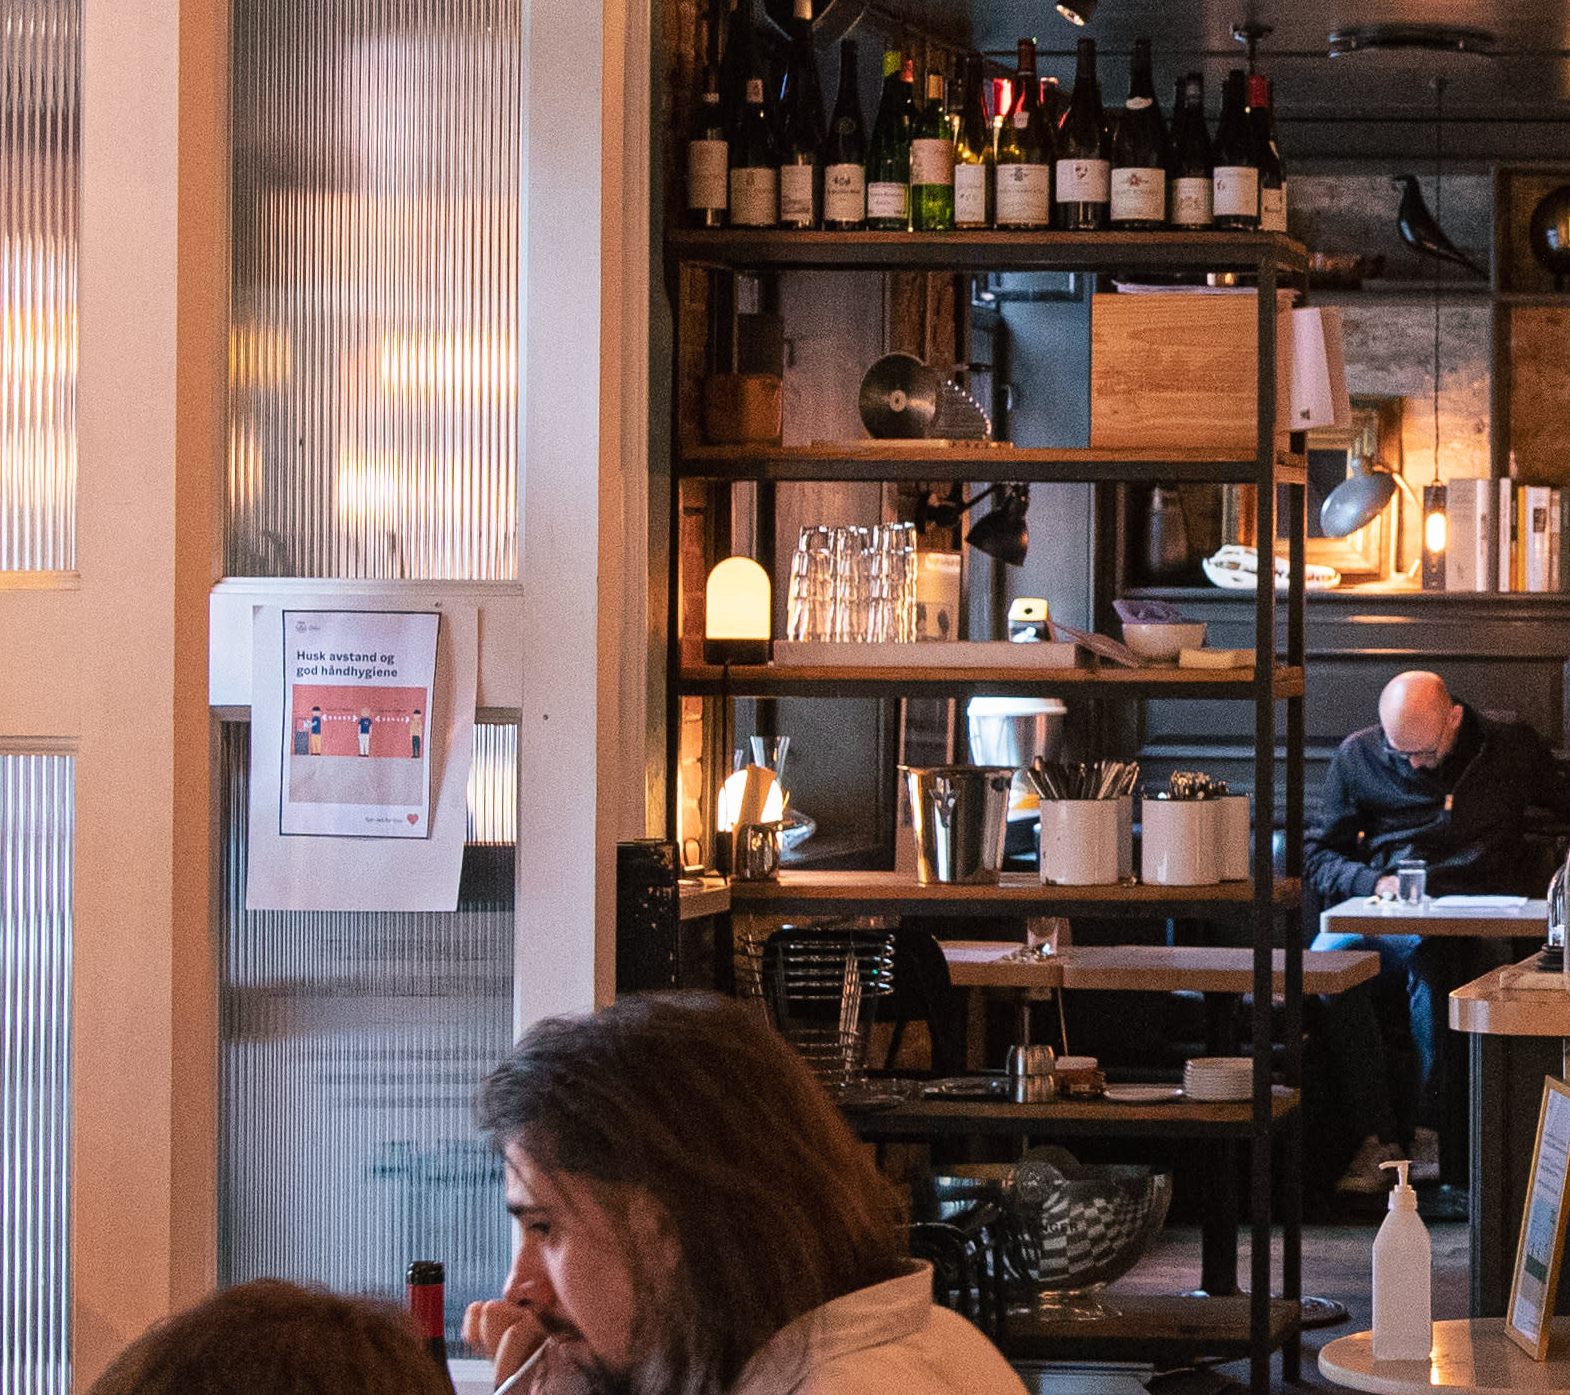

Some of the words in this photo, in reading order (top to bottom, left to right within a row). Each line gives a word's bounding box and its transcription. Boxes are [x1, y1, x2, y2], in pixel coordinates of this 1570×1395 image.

[297, 651, 326, 662] Husk
[329, 651, 377, 664] avstand
[379, 653, 395, 666] og
[296, 665, 319, 679] god
[321, 665, 398, 679] håndhygiene
